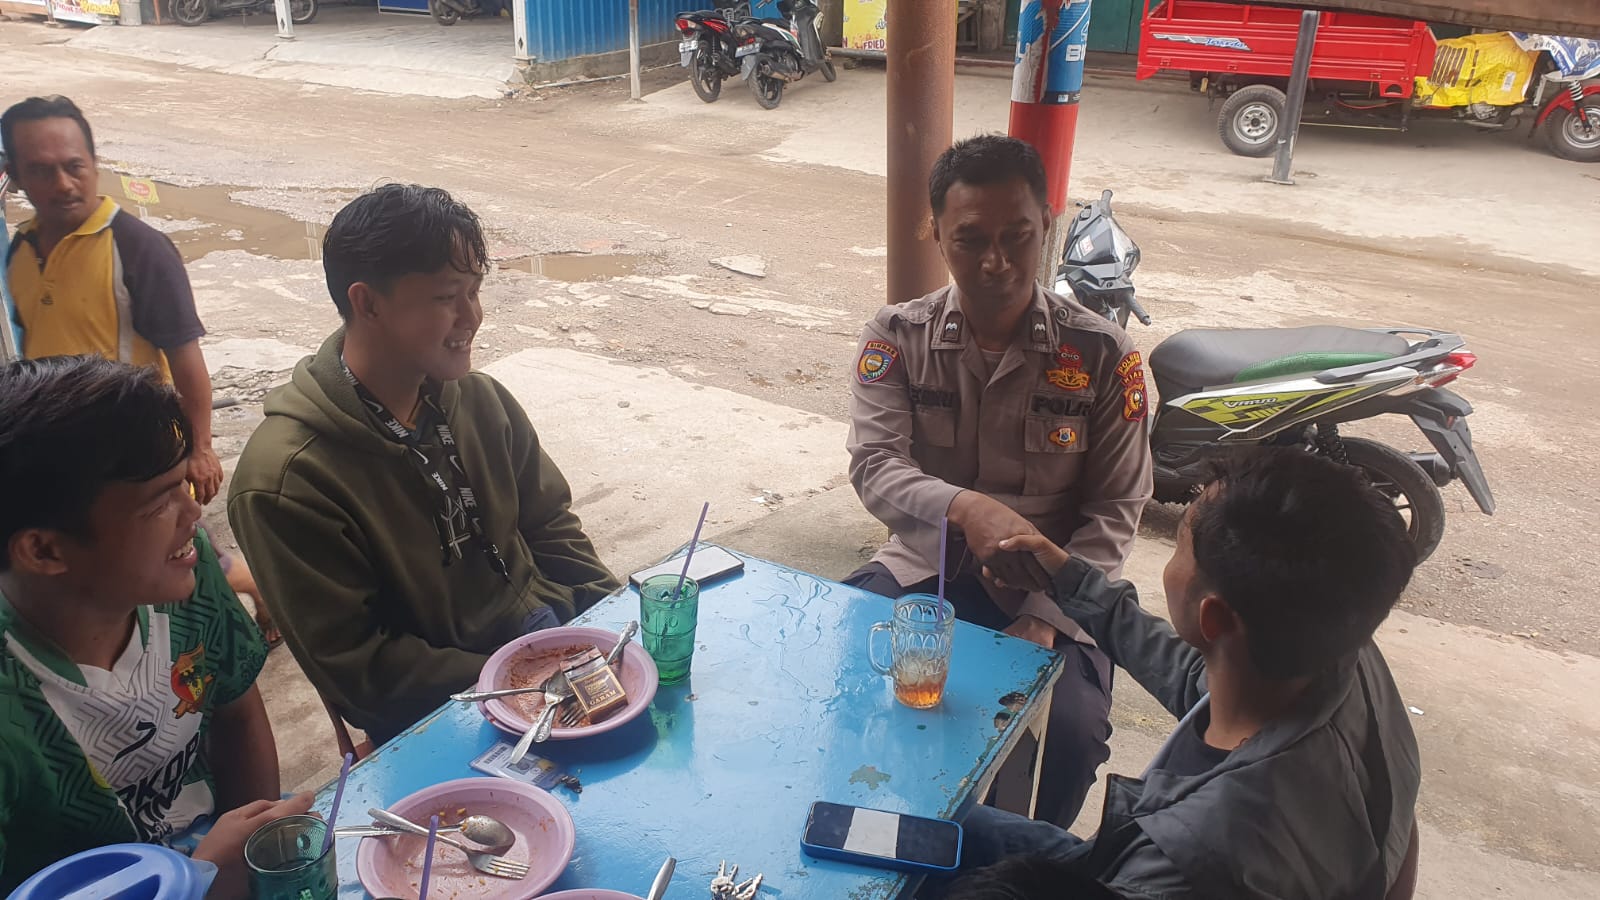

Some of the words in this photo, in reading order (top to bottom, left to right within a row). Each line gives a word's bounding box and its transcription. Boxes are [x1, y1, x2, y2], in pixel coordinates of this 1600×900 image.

[863, 38, 885, 50] FRIED
[384, 417, 409, 438] NIKE
[436, 424, 455, 446] NIKE
[431, 471, 448, 491] NIKE
[458, 487, 477, 508] NIKE
